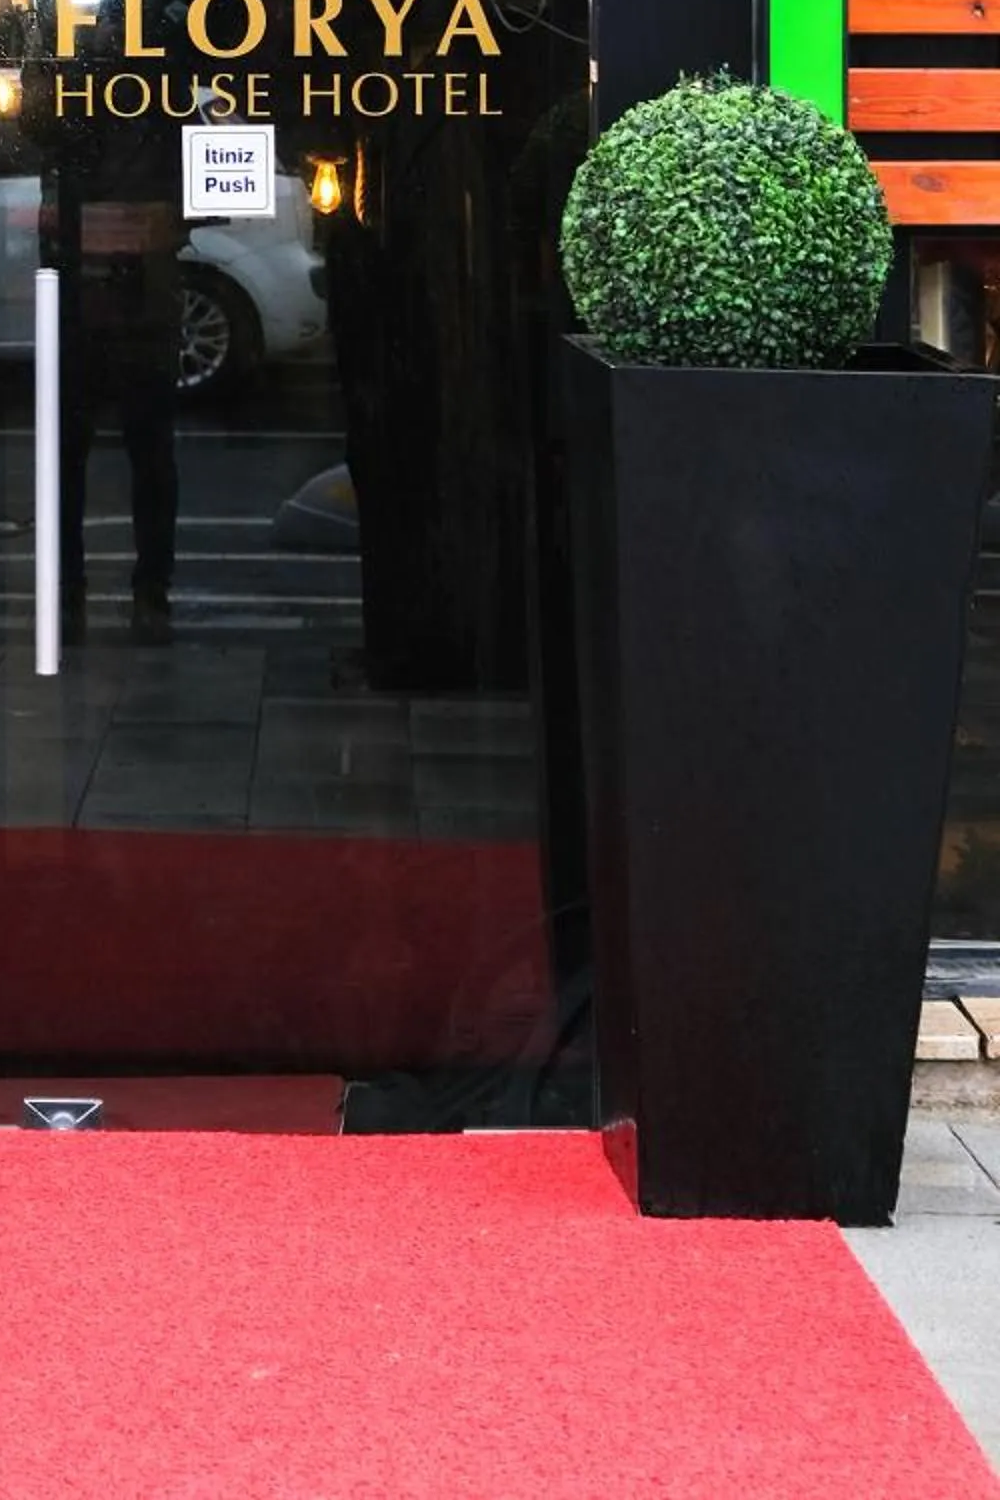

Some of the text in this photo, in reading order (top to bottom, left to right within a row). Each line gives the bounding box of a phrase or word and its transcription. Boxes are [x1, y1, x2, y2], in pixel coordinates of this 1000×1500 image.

[55, 72, 503, 118] HOUSE HOTEL
[205, 143, 254, 165] İtiniz
[205, 176, 256, 193] Push
